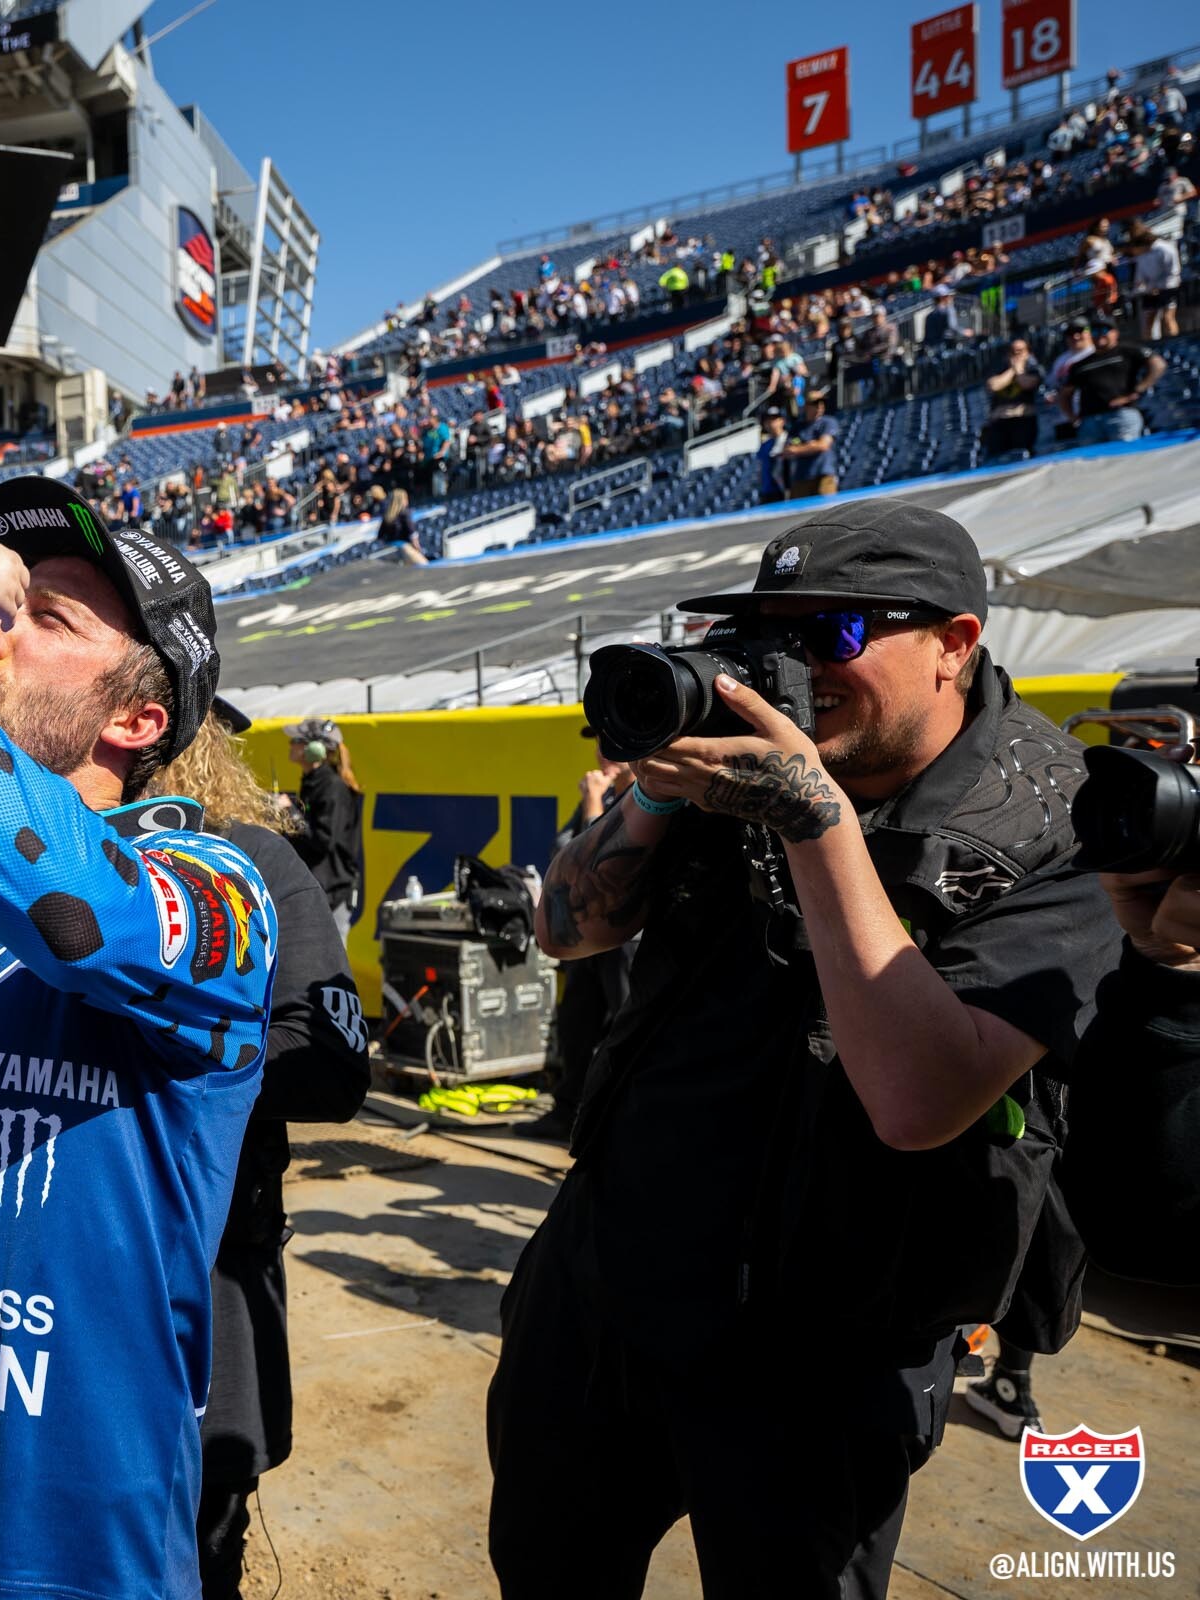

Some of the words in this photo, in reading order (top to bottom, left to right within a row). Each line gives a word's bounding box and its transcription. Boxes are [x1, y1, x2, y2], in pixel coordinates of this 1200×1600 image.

[2, 32, 31, 52] THE
[1011, 16, 1062, 71] 18
[913, 48, 971, 99] 44
[802, 91, 831, 136] 7
[6, 507, 71, 531] YAMAHA
[135, 537, 187, 585] YAMAHA
[707, 626, 737, 638] Nikon
